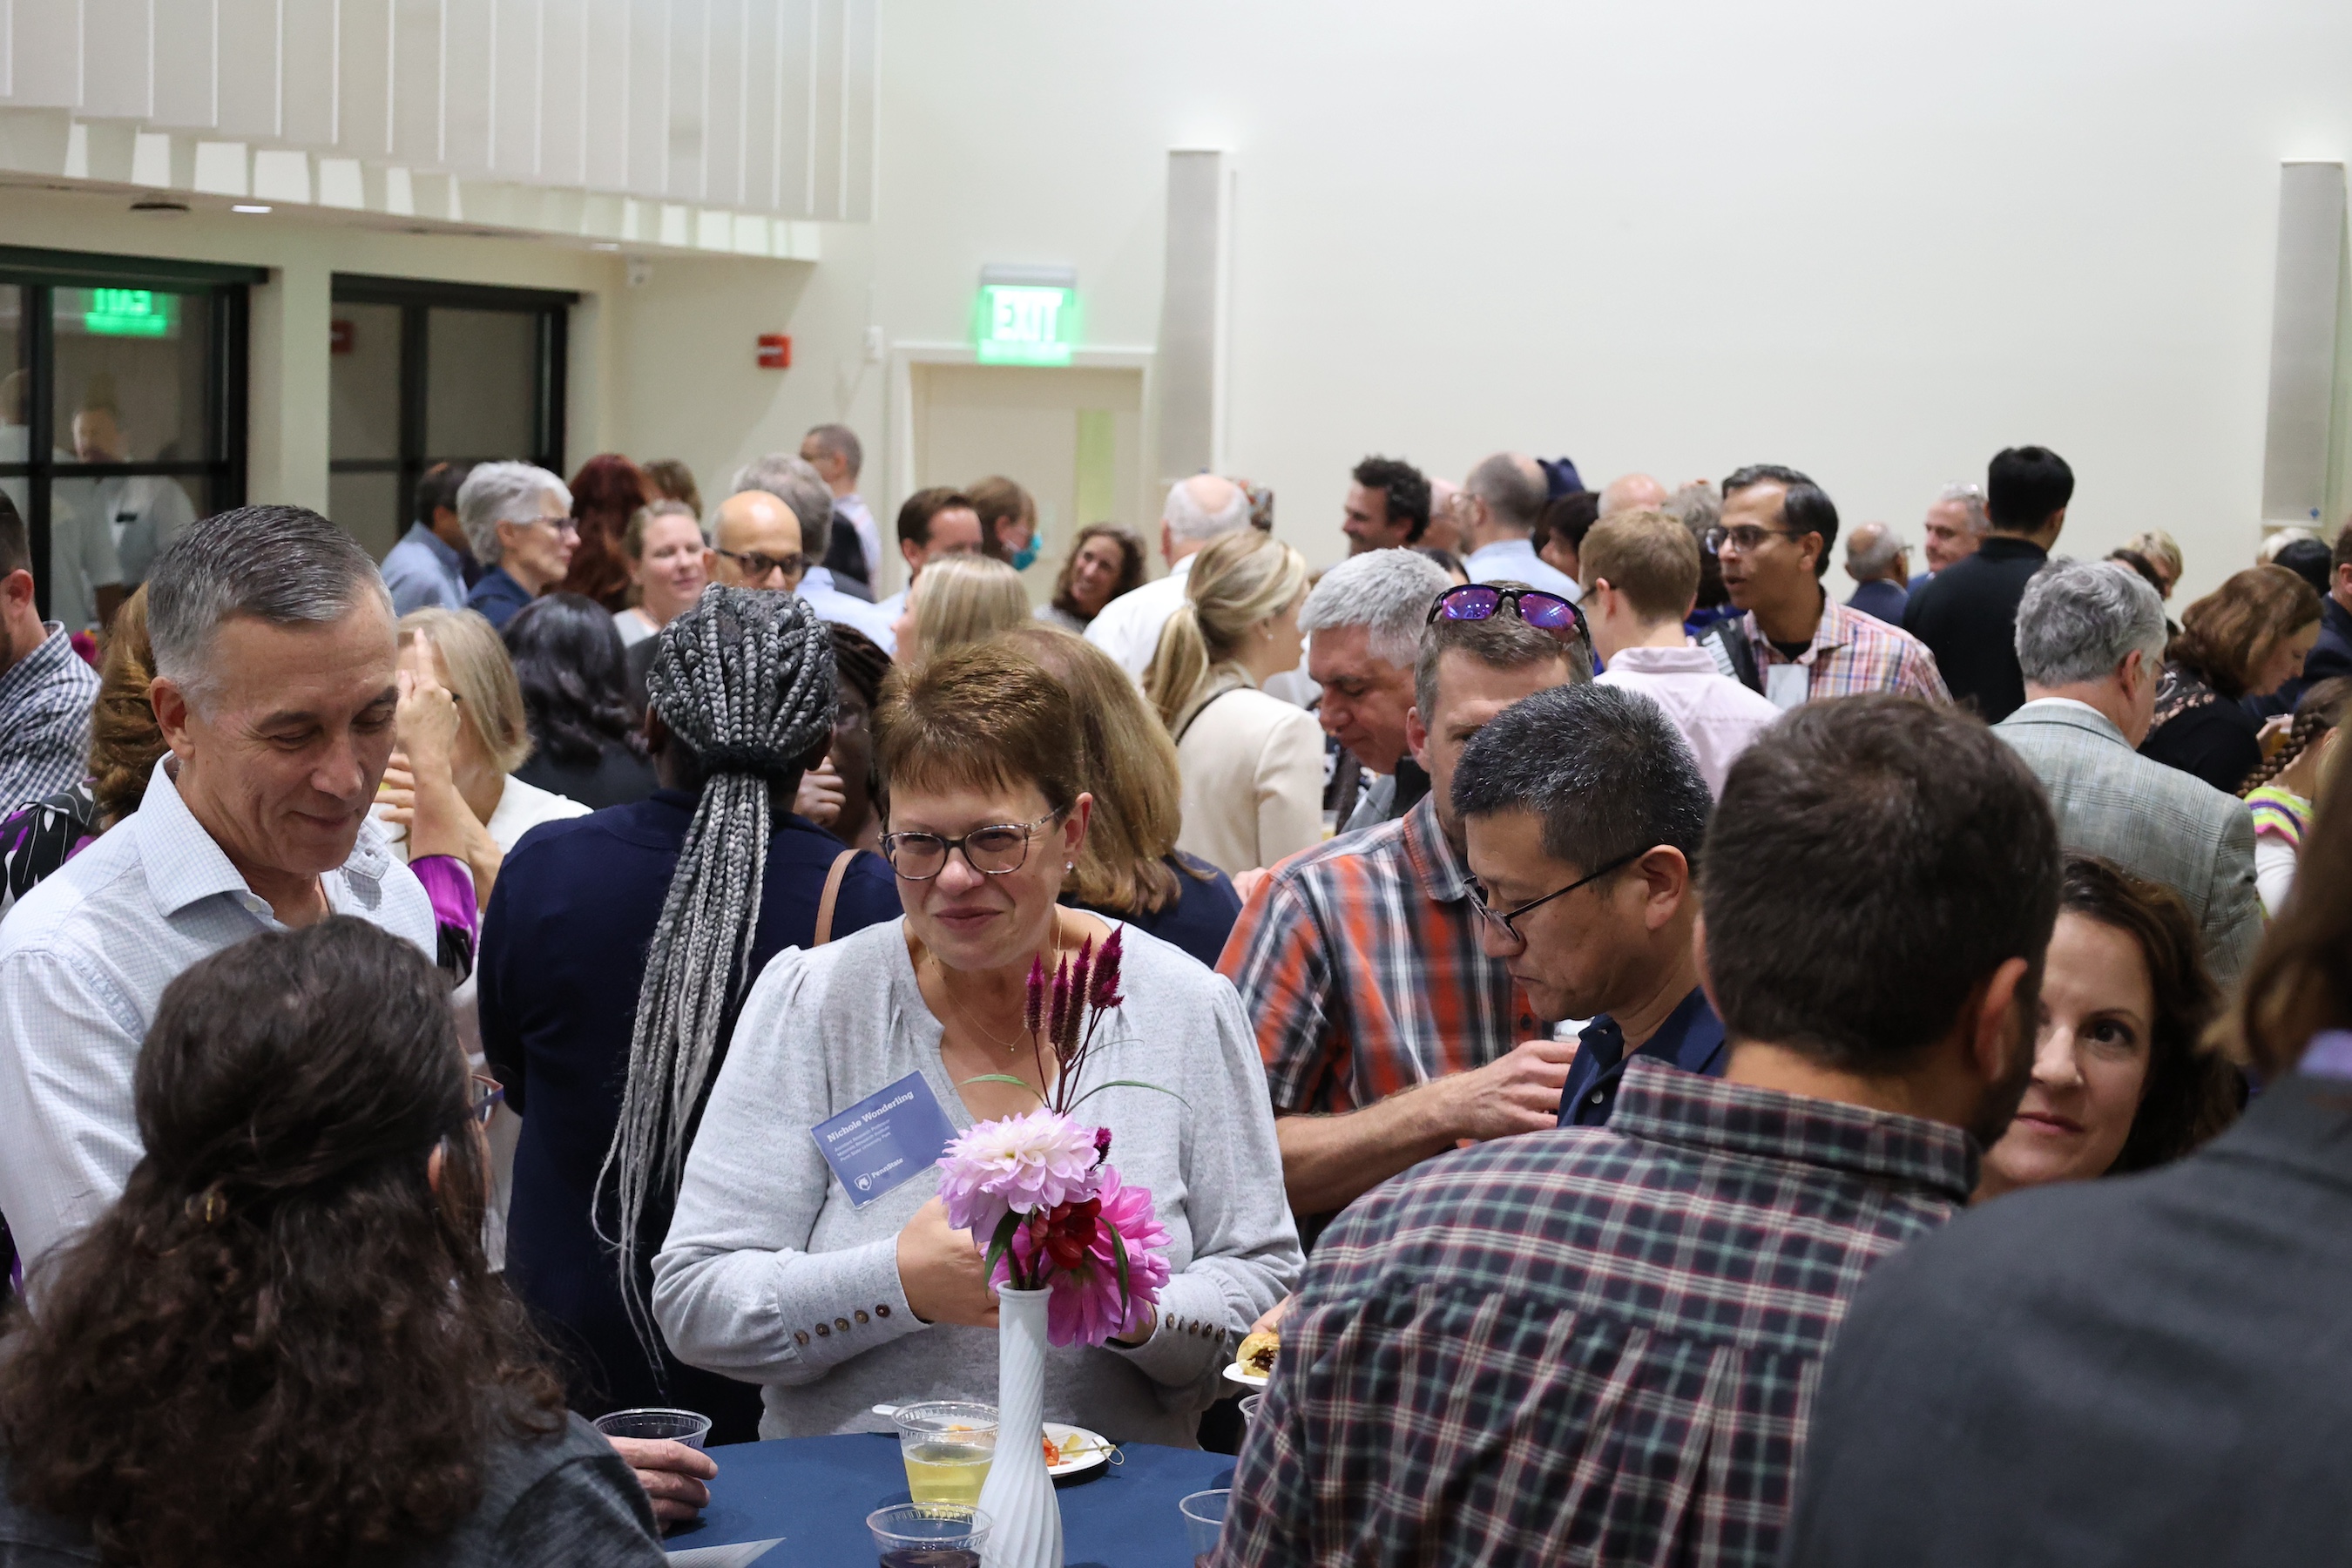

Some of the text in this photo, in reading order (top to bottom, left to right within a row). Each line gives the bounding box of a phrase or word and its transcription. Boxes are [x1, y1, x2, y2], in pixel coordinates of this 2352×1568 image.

[993, 291, 1063, 341] EXIT
[827, 1091, 915, 1143] Nichole Wonderling
